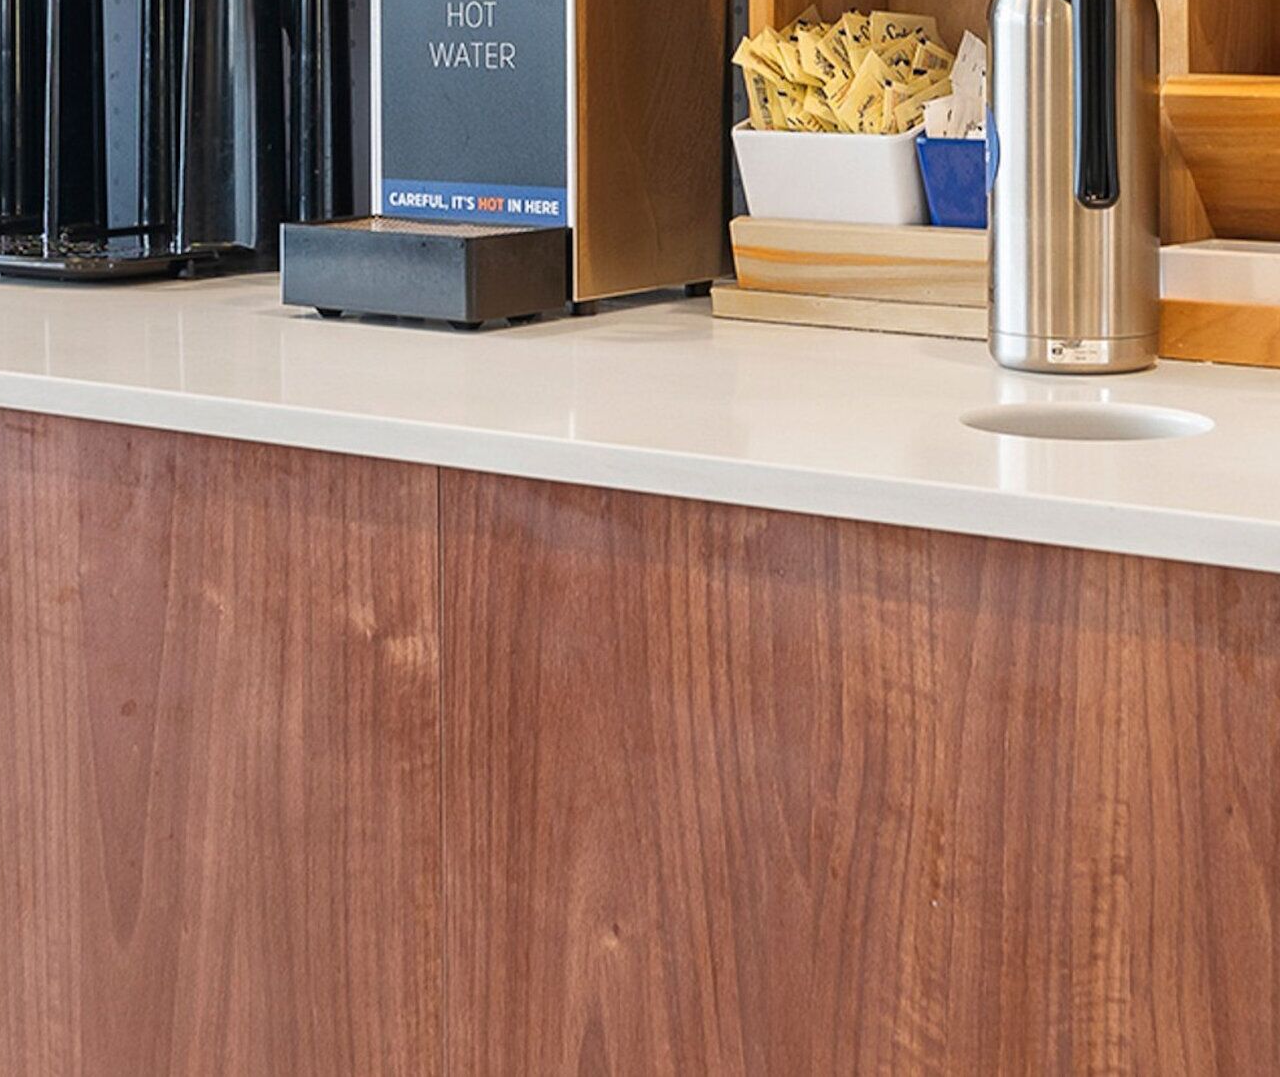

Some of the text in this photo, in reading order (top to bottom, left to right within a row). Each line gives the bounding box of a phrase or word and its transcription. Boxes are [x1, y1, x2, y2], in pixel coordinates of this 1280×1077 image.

[446, 0, 497, 30] HOT
[428, 41, 516, 70] WATER
[389, 191, 559, 216] CAREFUL, IT'S HOT IN HERE
